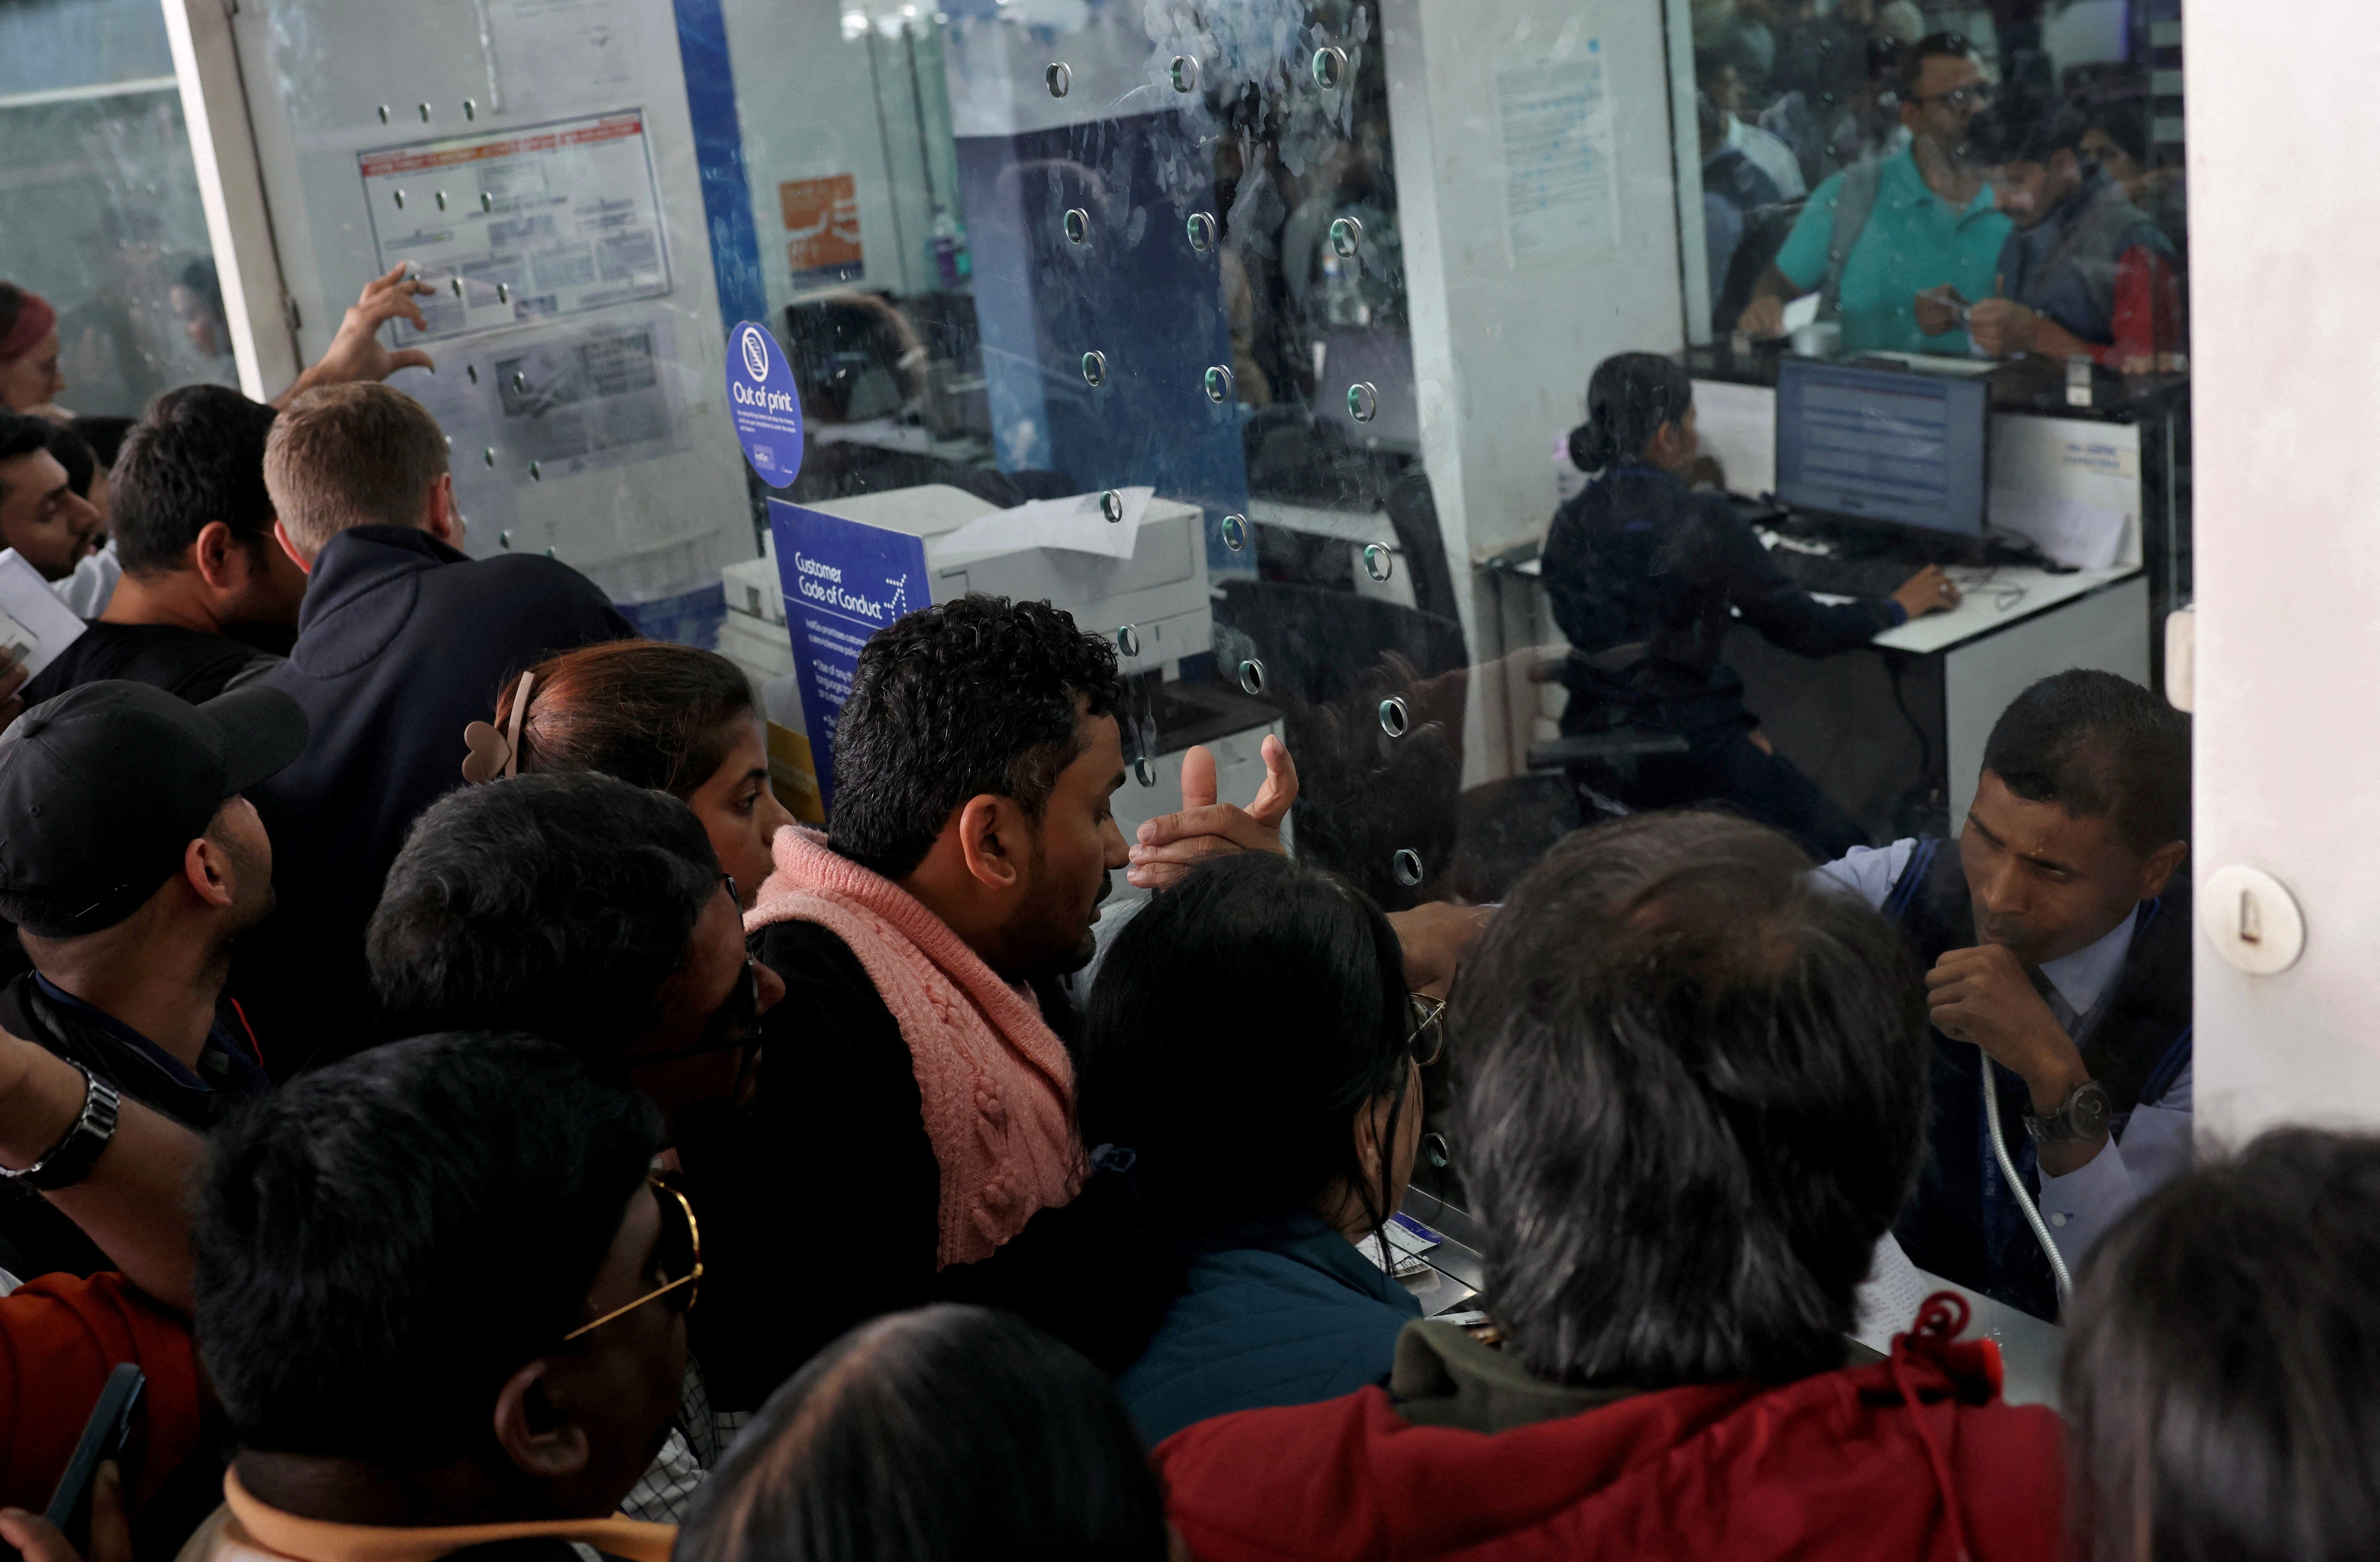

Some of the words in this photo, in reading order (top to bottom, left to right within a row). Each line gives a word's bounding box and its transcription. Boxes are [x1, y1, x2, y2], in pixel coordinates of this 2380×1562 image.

[733, 381, 755, 405] Out
[755, 386, 766, 407] of
[768, 390, 793, 414] print
[795, 551, 841, 584] Customer
[799, 575, 826, 601] Code
[826, 585, 837, 605] of
[838, 588, 883, 620] Conduct
